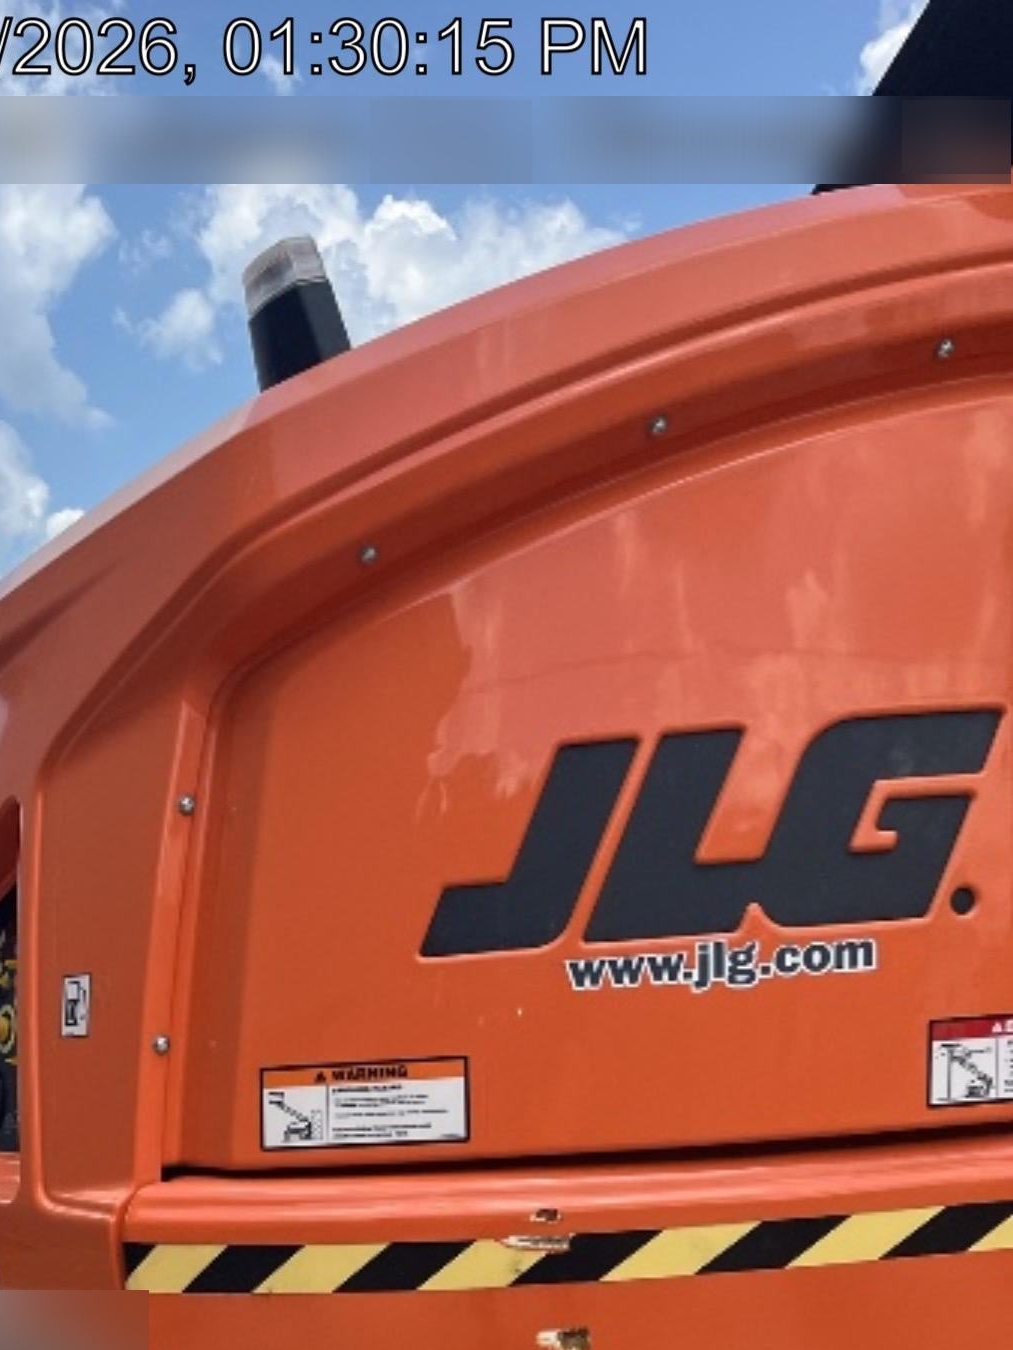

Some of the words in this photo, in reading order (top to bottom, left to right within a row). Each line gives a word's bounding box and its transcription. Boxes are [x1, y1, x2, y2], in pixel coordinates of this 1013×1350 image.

[420, 711, 1001, 957] JLG
[567, 938, 875, 990] www.jlg.com
[332, 1065, 408, 1080] WARNING
